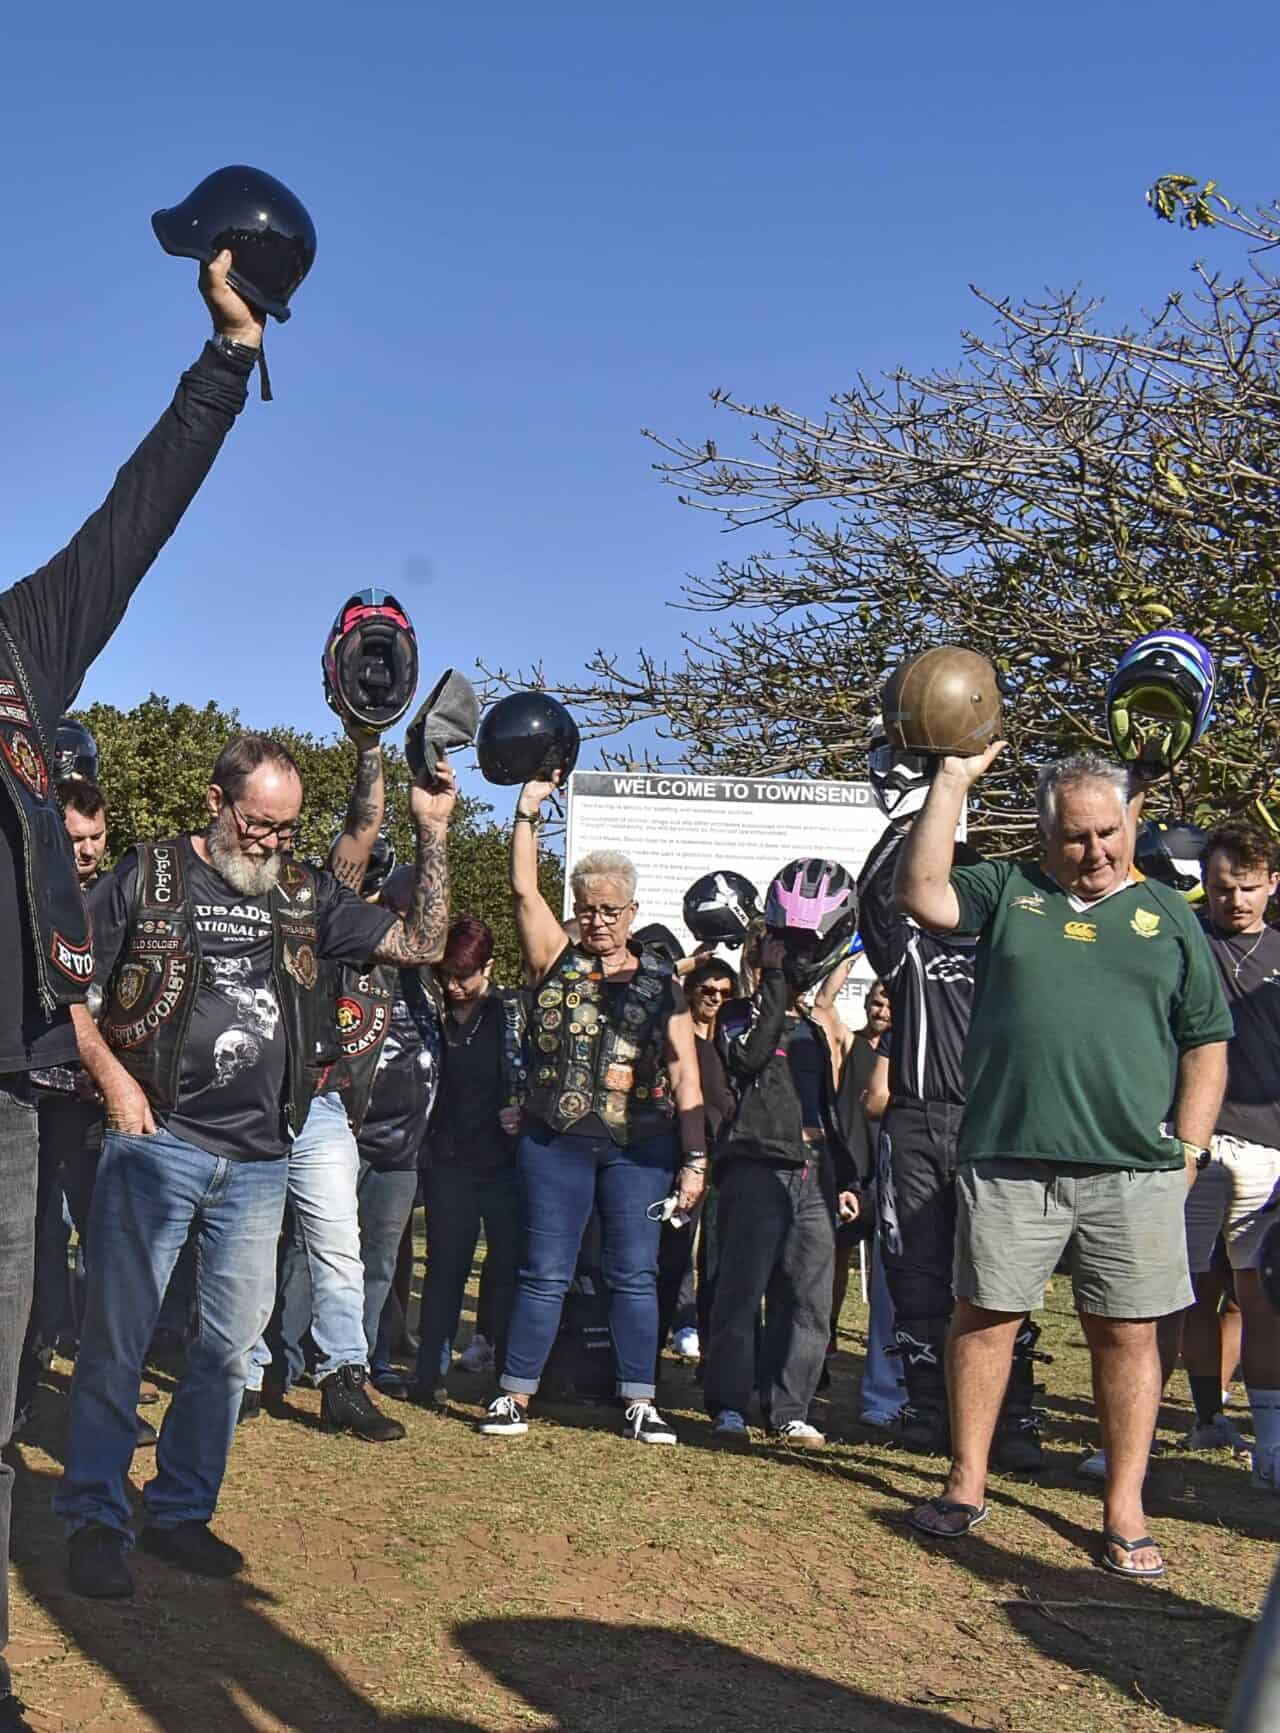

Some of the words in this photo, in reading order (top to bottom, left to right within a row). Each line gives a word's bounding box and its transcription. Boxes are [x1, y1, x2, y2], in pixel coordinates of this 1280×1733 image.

[614, 778, 716, 798] WELCOME
[722, 783, 749, 799] TO
[754, 784, 869, 805] TOWNSEND
[194, 904, 272, 925] USADE
[147, 959, 187, 1028] COAST
